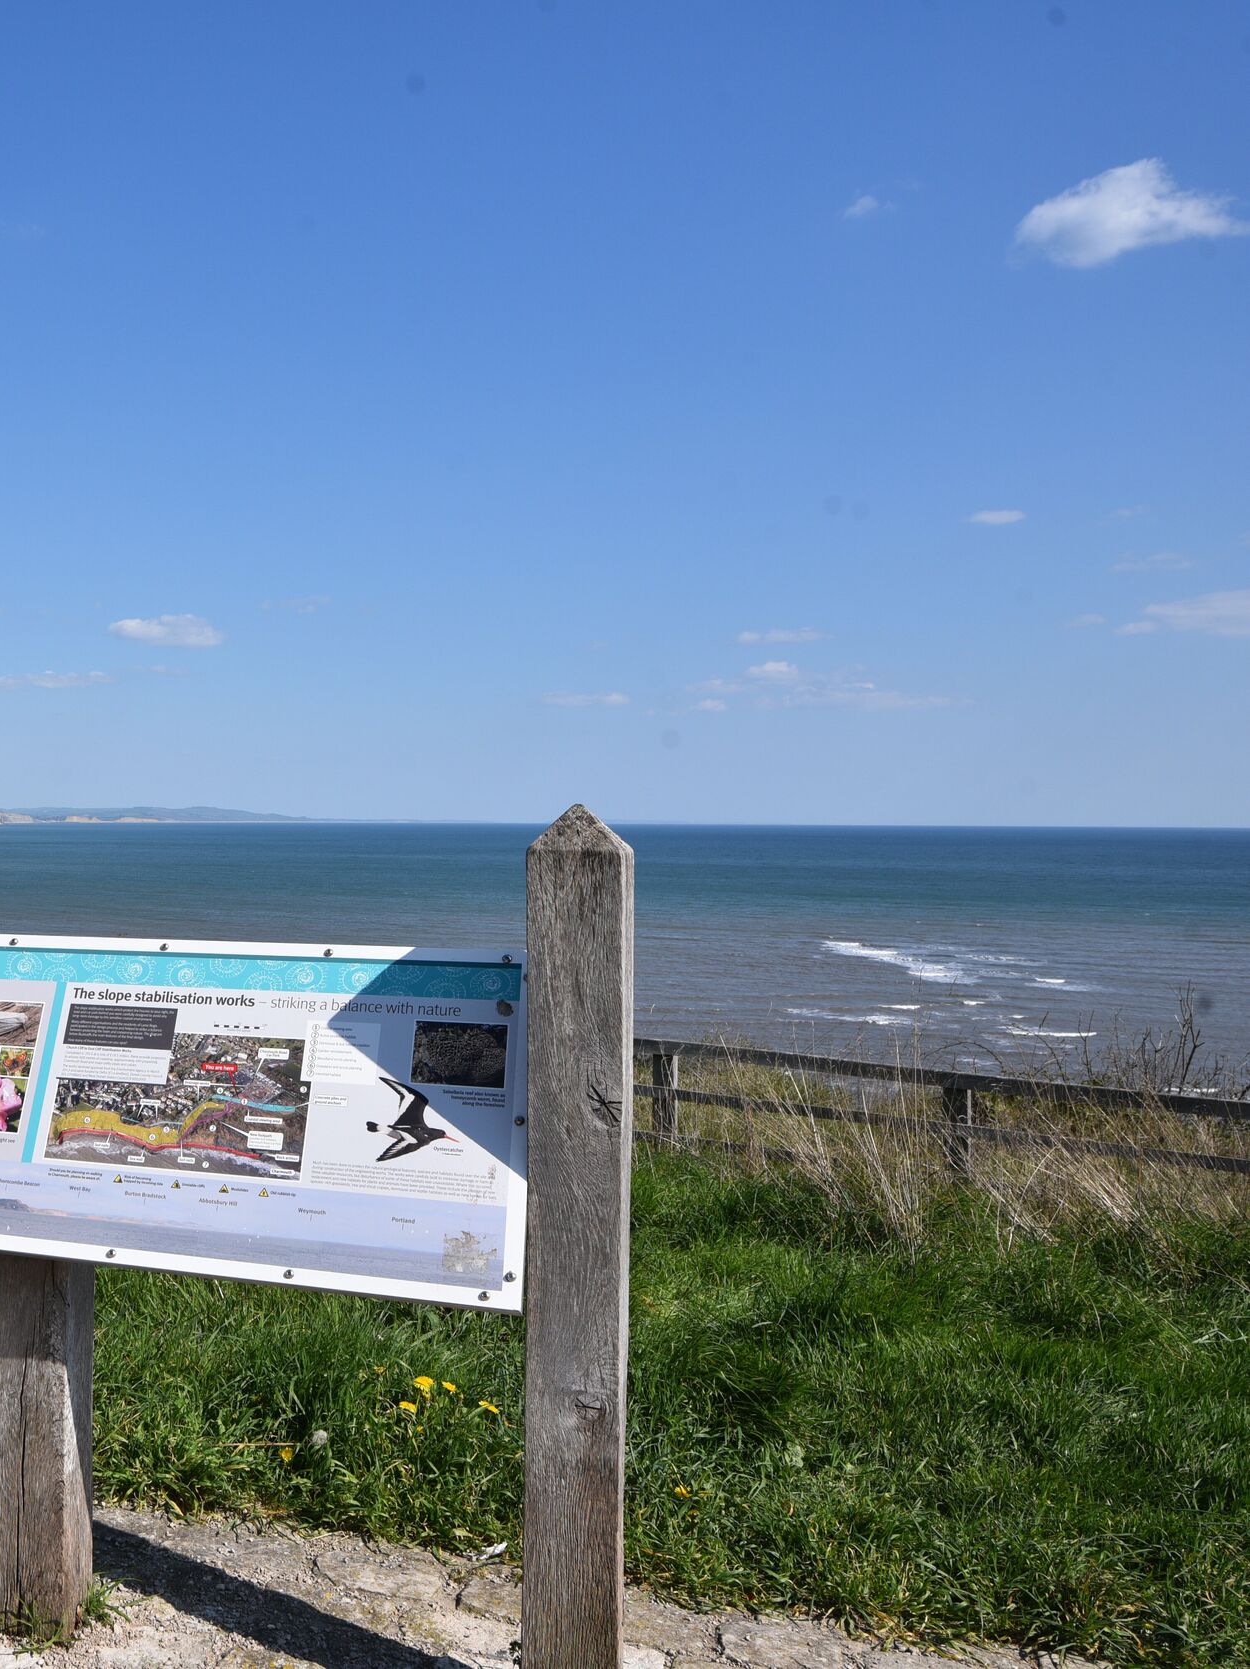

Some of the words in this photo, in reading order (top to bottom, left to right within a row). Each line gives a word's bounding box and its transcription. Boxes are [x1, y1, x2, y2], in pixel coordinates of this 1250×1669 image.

[72, 987, 95, 1000] The
[97, 988, 132, 1004] slope
[133, 989, 213, 1006] stabilisation
[216, 993, 256, 1008] works
[270, 995, 317, 1012] striking
[319, 1001, 327, 1010] a
[331, 999, 387, 1014] balance
[390, 1001, 414, 1015] with
[416, 1004, 462, 1017] nature
[198, 1198, 228, 1206] Abbotsbury
[297, 1207, 327, 1215] Weymouth
[391, 1216, 416, 1224] Portland
